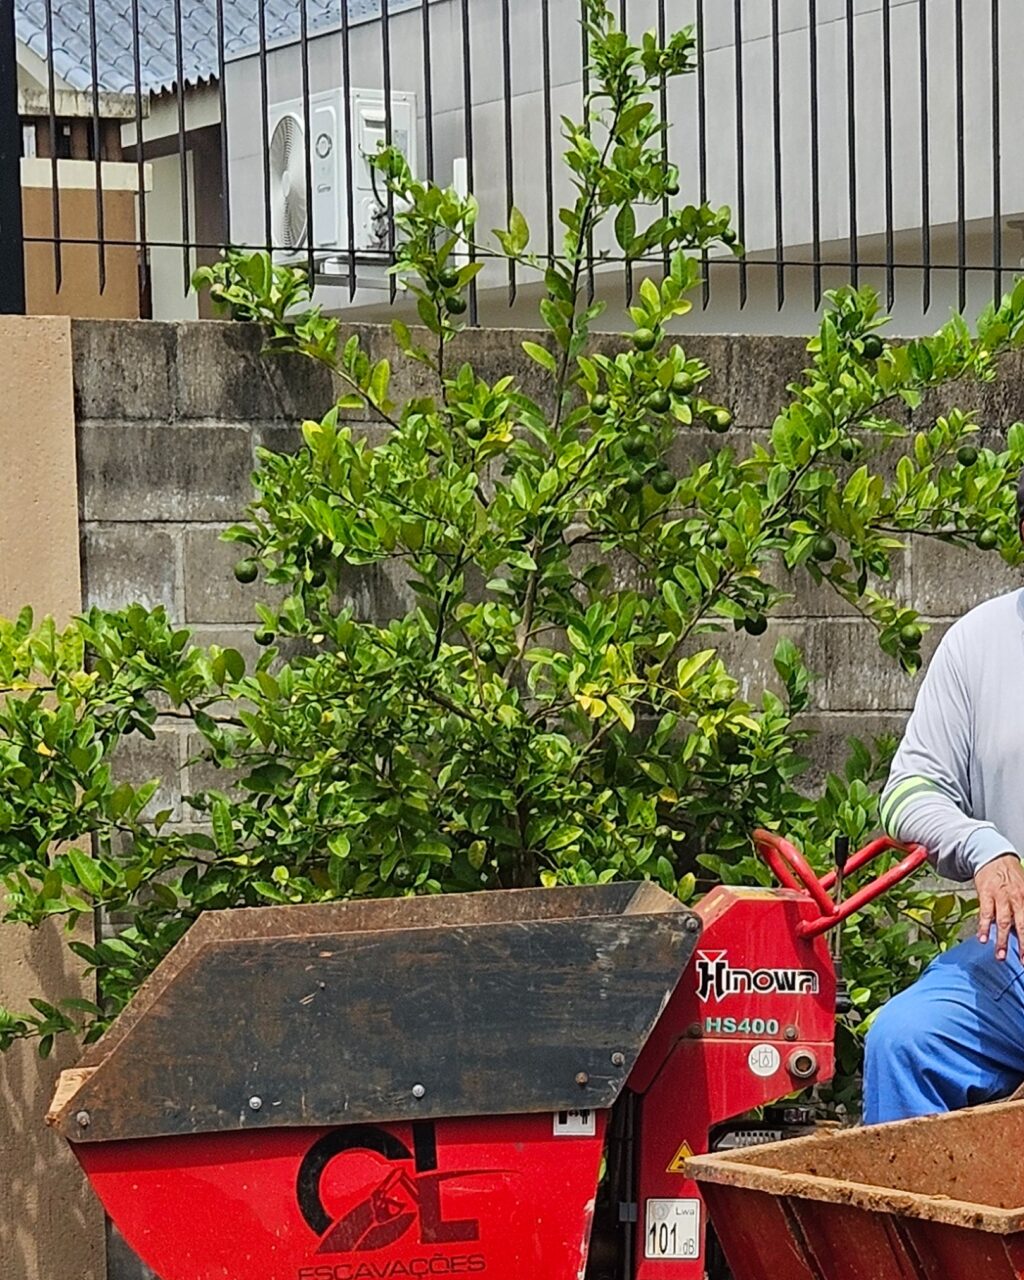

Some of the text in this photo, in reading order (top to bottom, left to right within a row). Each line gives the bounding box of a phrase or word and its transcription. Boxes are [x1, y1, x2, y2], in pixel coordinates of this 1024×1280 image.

[705, 1016, 779, 1035] HS400
[649, 1222, 695, 1255] 101 dB
